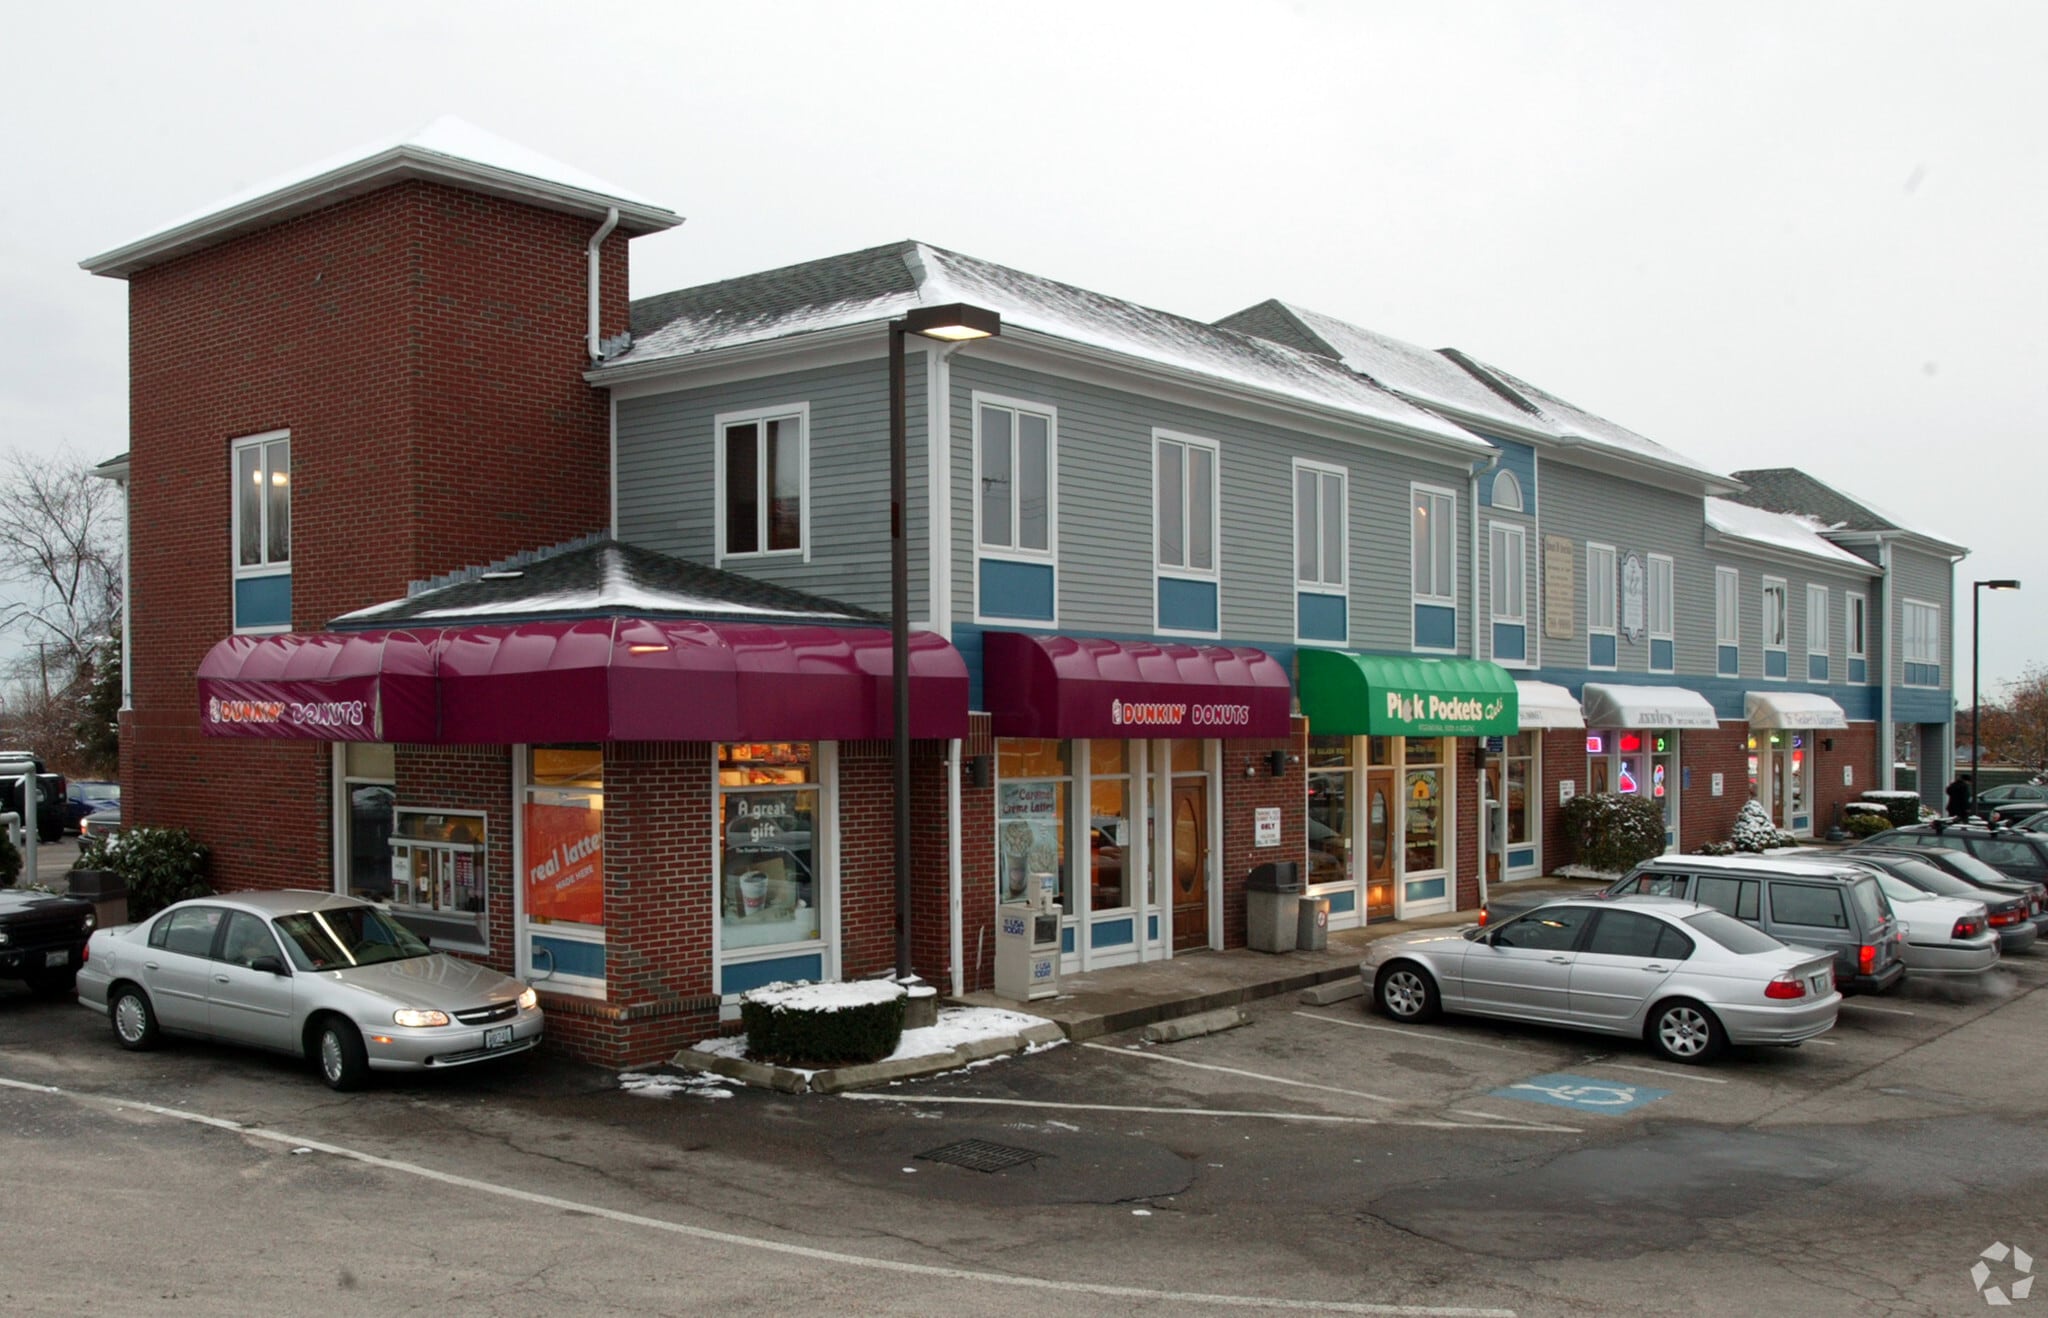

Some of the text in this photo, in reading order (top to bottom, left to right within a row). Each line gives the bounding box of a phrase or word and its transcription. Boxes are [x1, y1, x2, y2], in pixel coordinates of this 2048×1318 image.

[290, 700, 364, 726] DONUTS
[1192, 704, 1249, 725] DONUTS
[1428, 695, 1482, 720] Pockets
[738, 800, 786, 820] A great
[750, 822, 775, 843] gift
[530, 848, 560, 885] real
